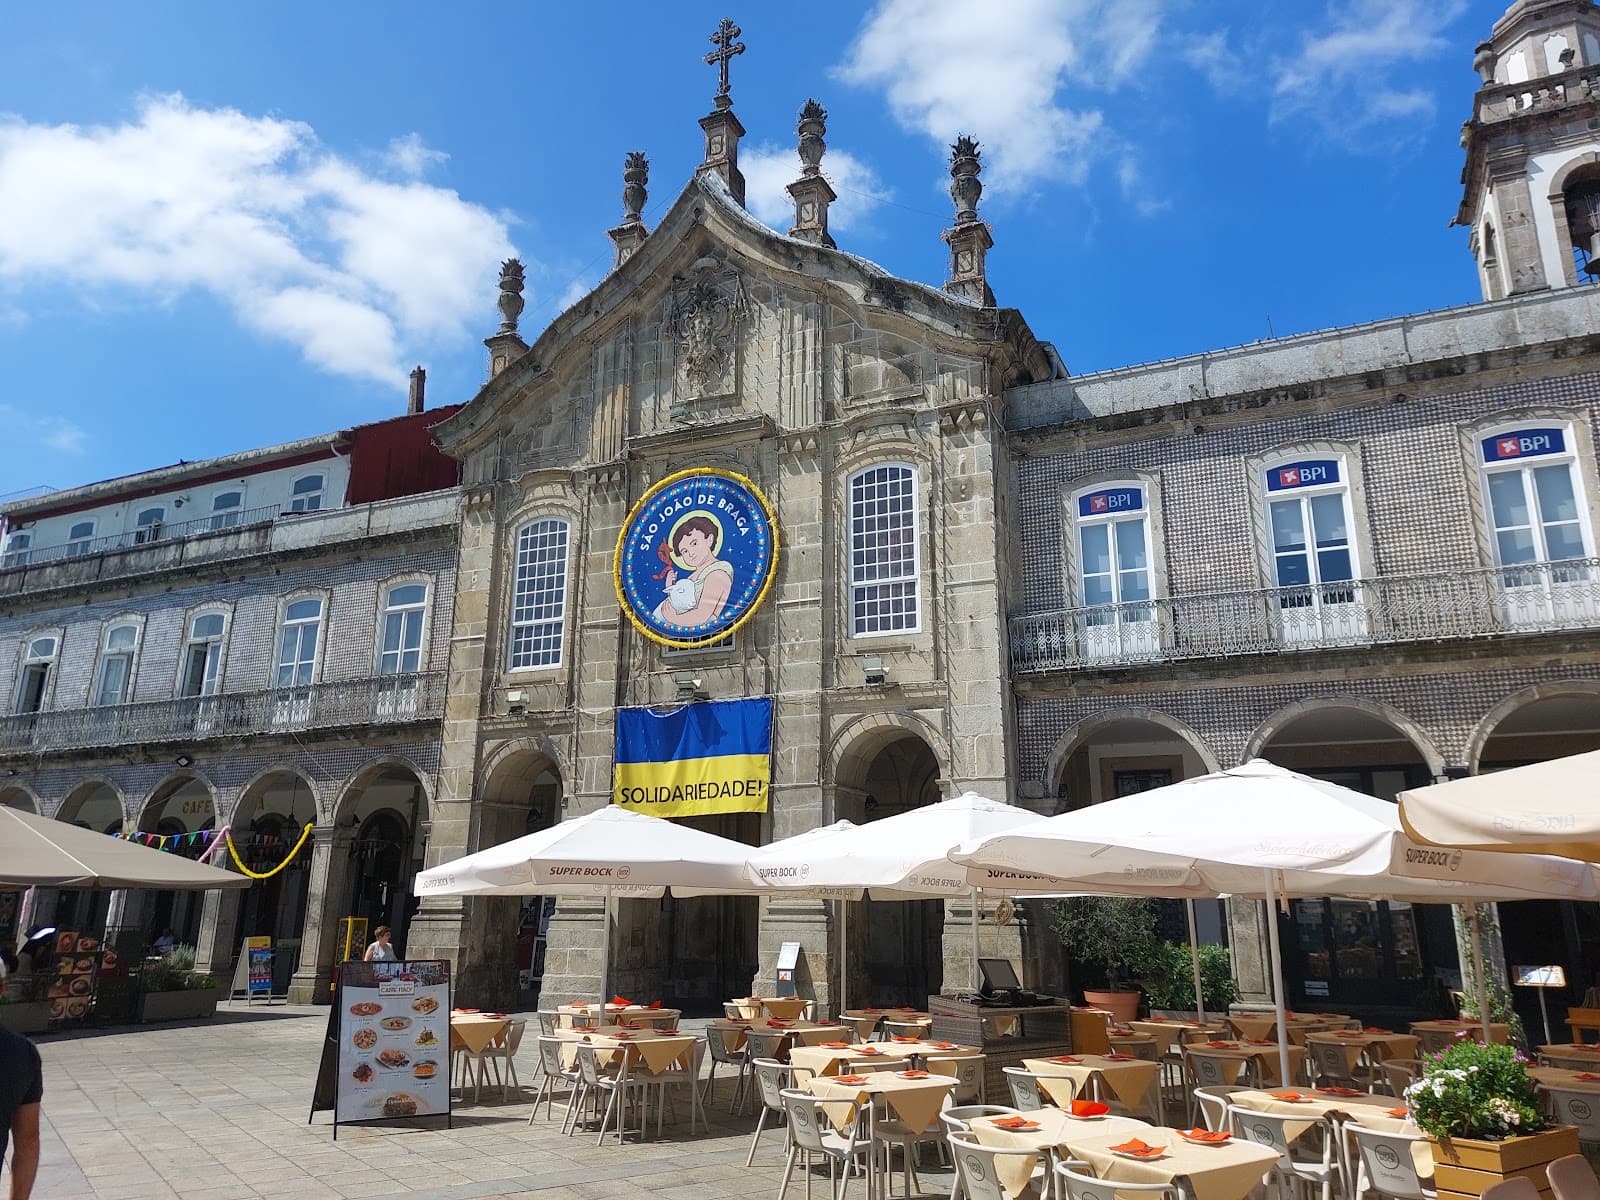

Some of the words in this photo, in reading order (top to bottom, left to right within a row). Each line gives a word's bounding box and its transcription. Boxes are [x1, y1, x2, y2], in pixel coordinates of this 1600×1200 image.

[1519, 435, 1551, 452] BPI
[1299, 466, 1327, 482] BPI
[1107, 493, 1131, 508] BPI
[640, 523, 658, 551] SÃO
[659, 496, 693, 523] JOÃO
[697, 494, 716, 505] DE
[717, 498, 750, 537] BRAGA
[620, 779, 763, 804] SOLIDARIEDADE!
[1406, 847, 1429, 864] SUPER
[1428, 851, 1451, 867] BOCK
[549, 866, 582, 876] SUPER
[583, 867, 613, 877] BOCK
[759, 866, 778, 878] SUPER
[778, 864, 797, 877] BOCK
